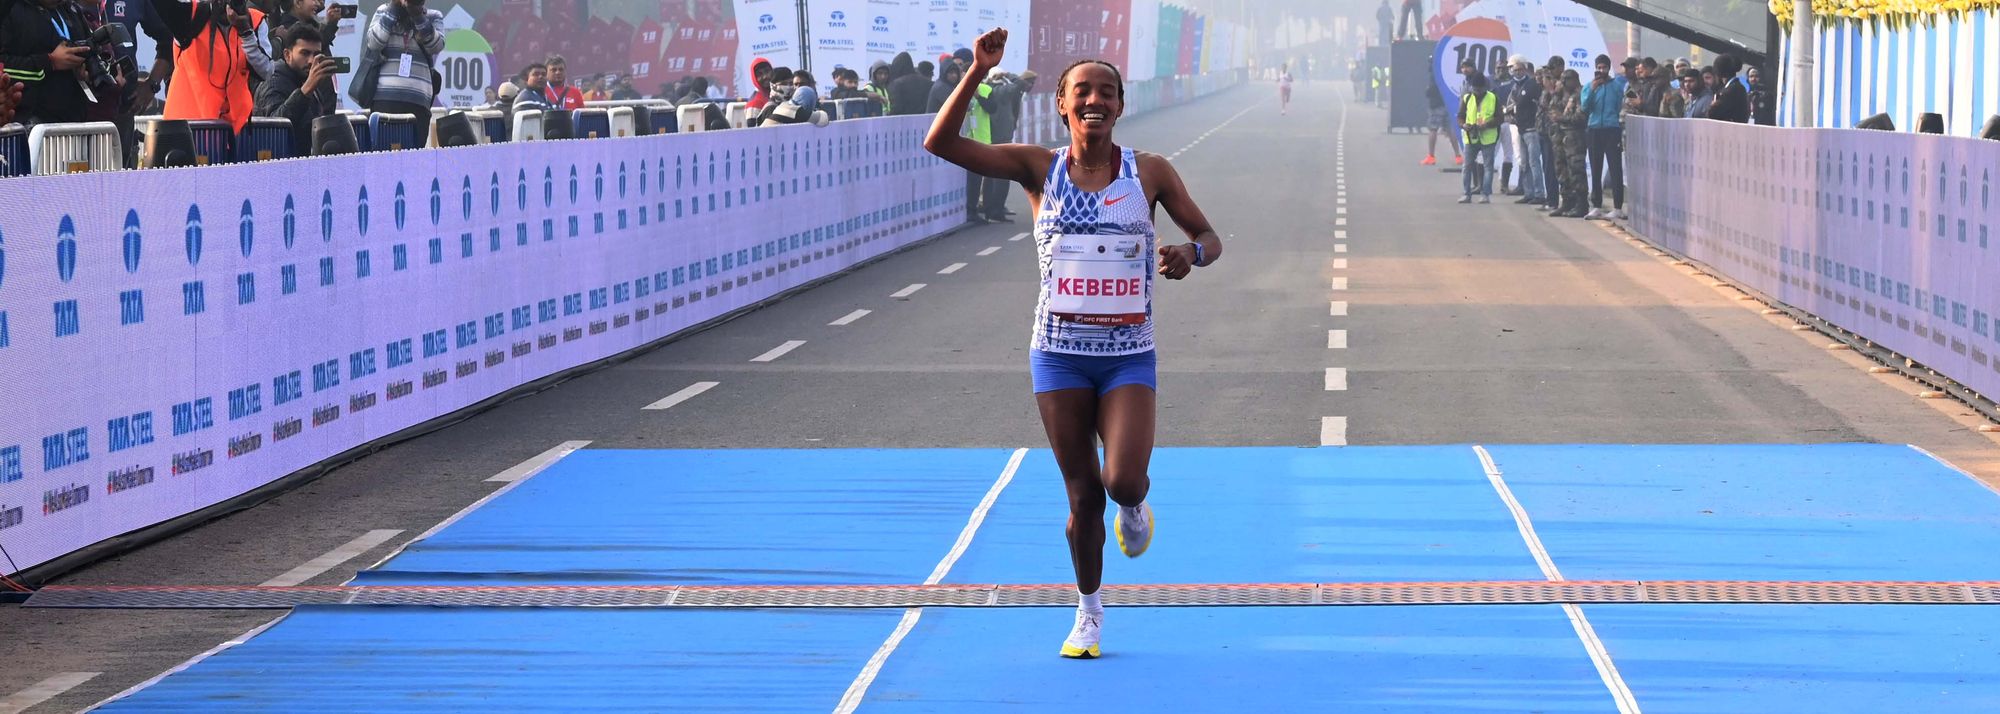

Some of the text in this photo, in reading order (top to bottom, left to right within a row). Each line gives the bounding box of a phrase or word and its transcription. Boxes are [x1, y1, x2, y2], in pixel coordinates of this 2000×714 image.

[442, 57, 483, 91] 100
[356, 249, 370, 279] TATA
[393, 243, 407, 271] TATA
[429, 237, 442, 264] TATA
[281, 264, 296, 296] TATA
[320, 256, 334, 287] TATA
[1057, 278, 1140, 297] KEBEDE
[182, 280, 205, 316] TATA
[237, 272, 255, 306] TATA
[53, 299, 80, 338] TATA
[119, 289, 144, 326] TATA
[386, 338, 413, 369] TATA STEEL
[423, 329, 447, 359] TATA STEEL
[313, 358, 340, 393] TATA STEEL
[350, 348, 376, 380] TATA STEEL
[228, 383, 262, 421] TATA STEEL
[273, 370, 302, 406] TATA STEEL
[107, 410, 155, 453] TATA STEEL
[172, 396, 213, 437] TATA STEEL
[43, 427, 90, 473] TATA STEEL
